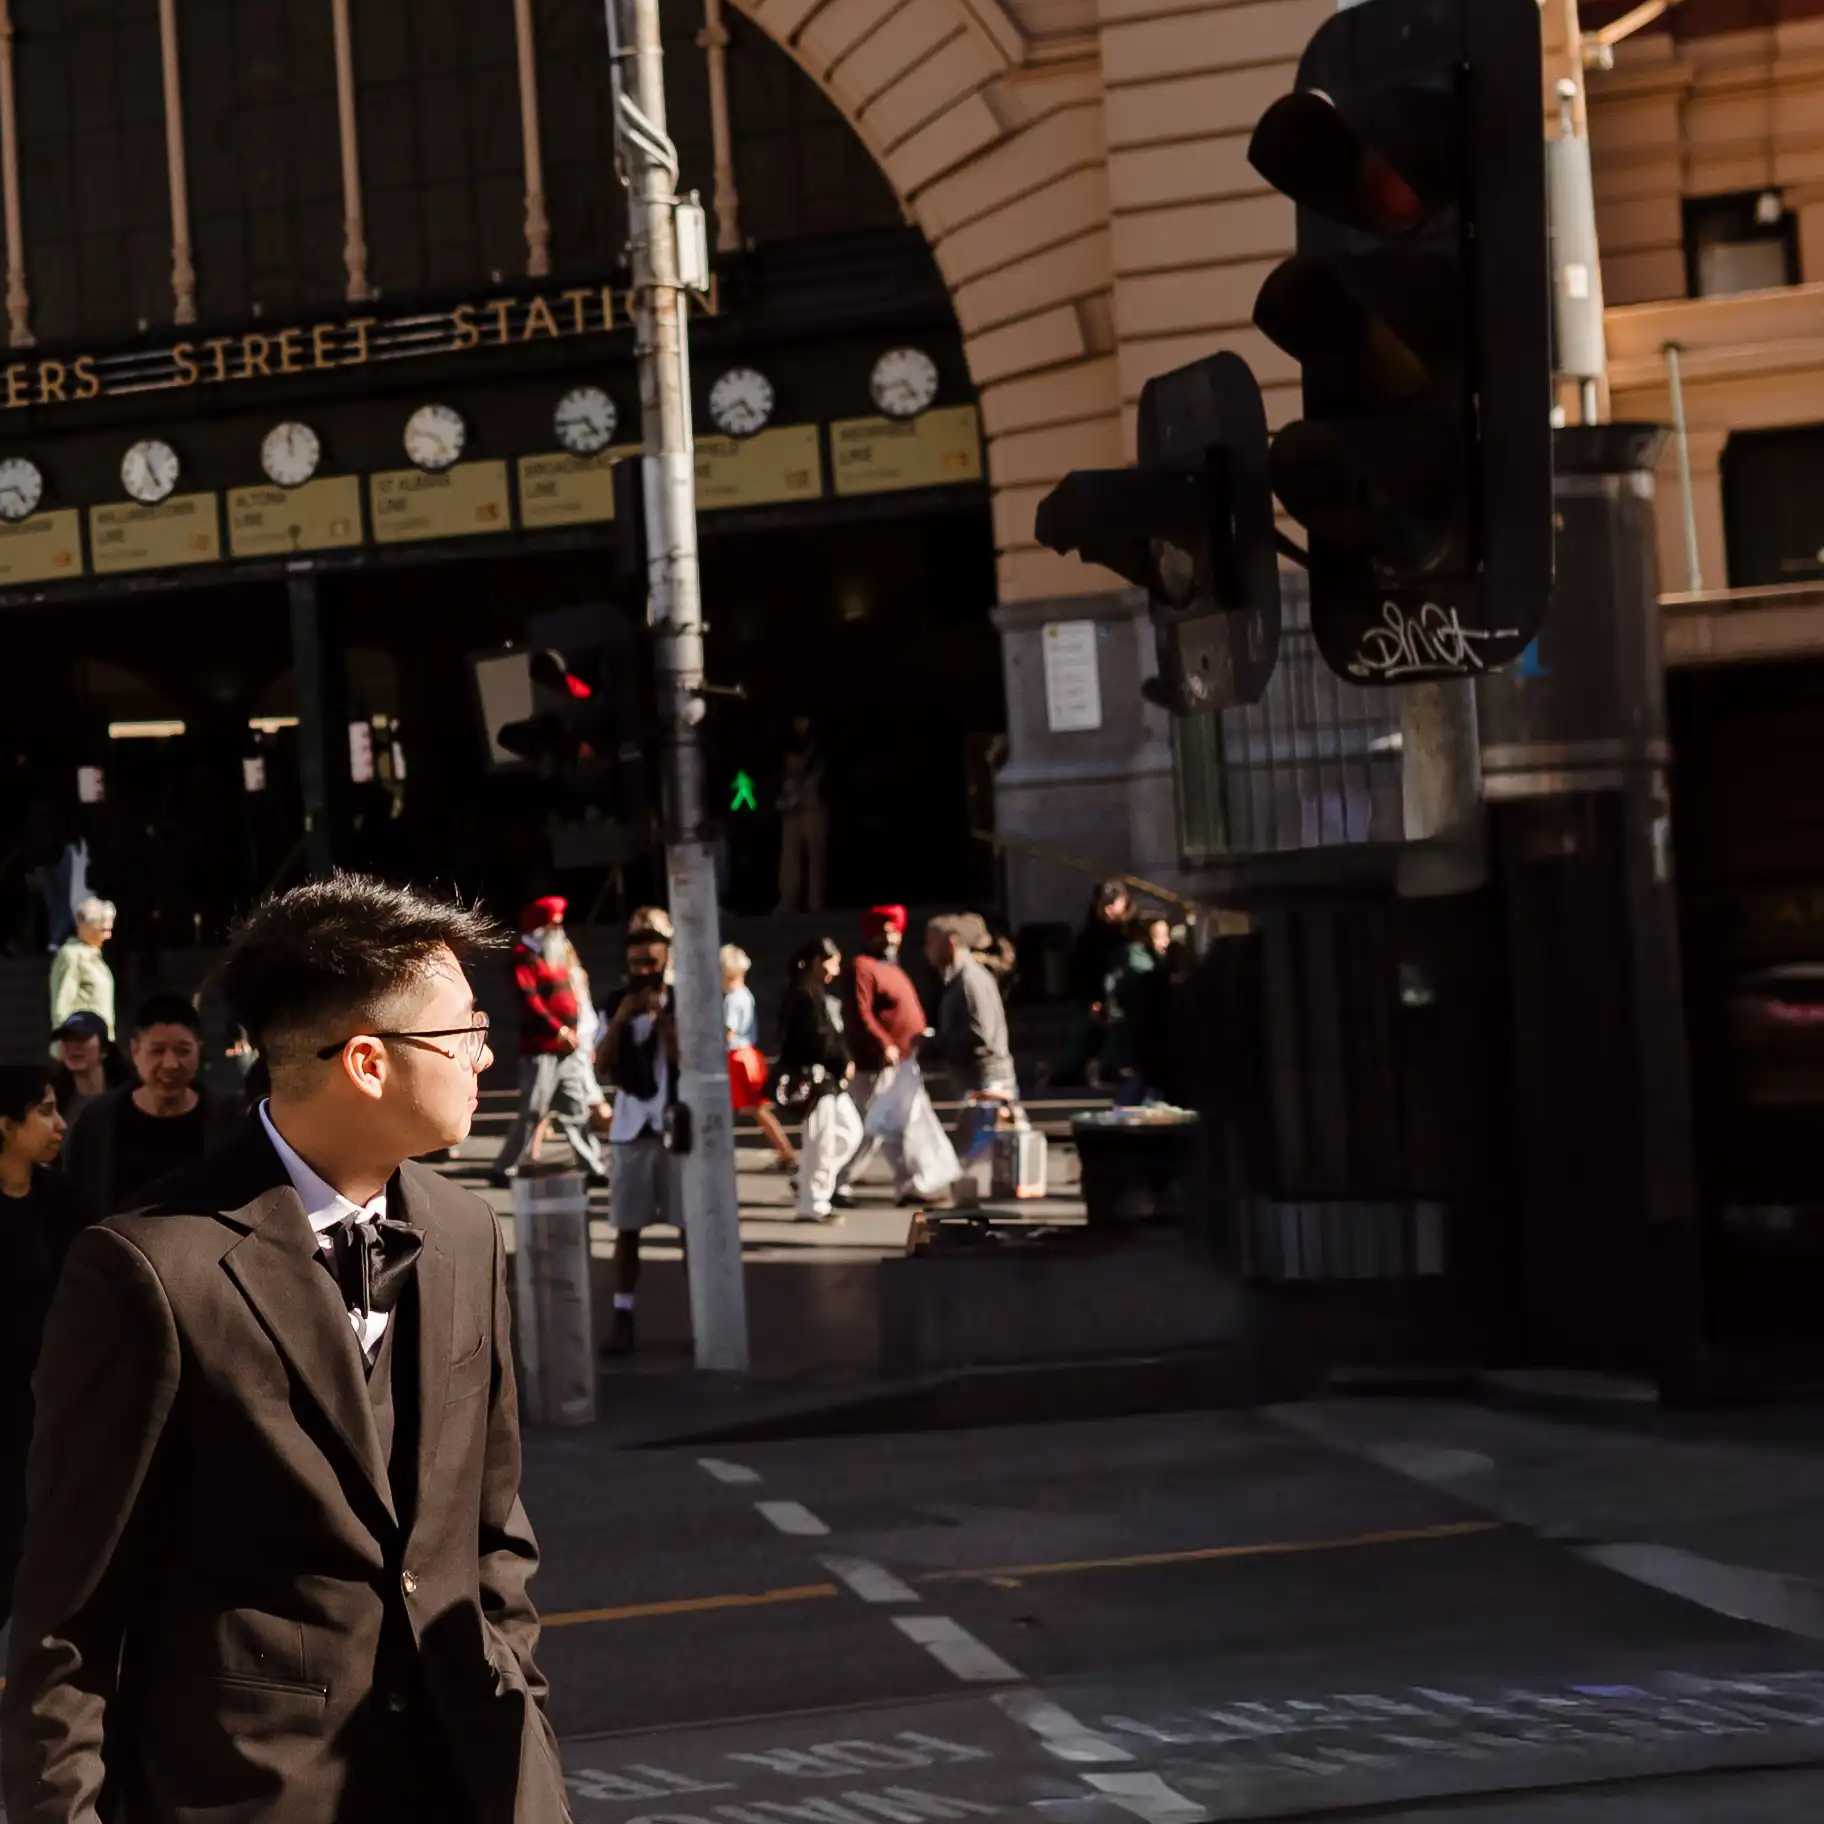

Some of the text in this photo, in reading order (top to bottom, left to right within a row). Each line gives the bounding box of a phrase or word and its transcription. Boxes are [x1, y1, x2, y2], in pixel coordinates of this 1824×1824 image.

[173, 317, 377, 385] STREET
[452, 272, 719, 350] STATIN
[725, 1731, 995, 1776] FOR
